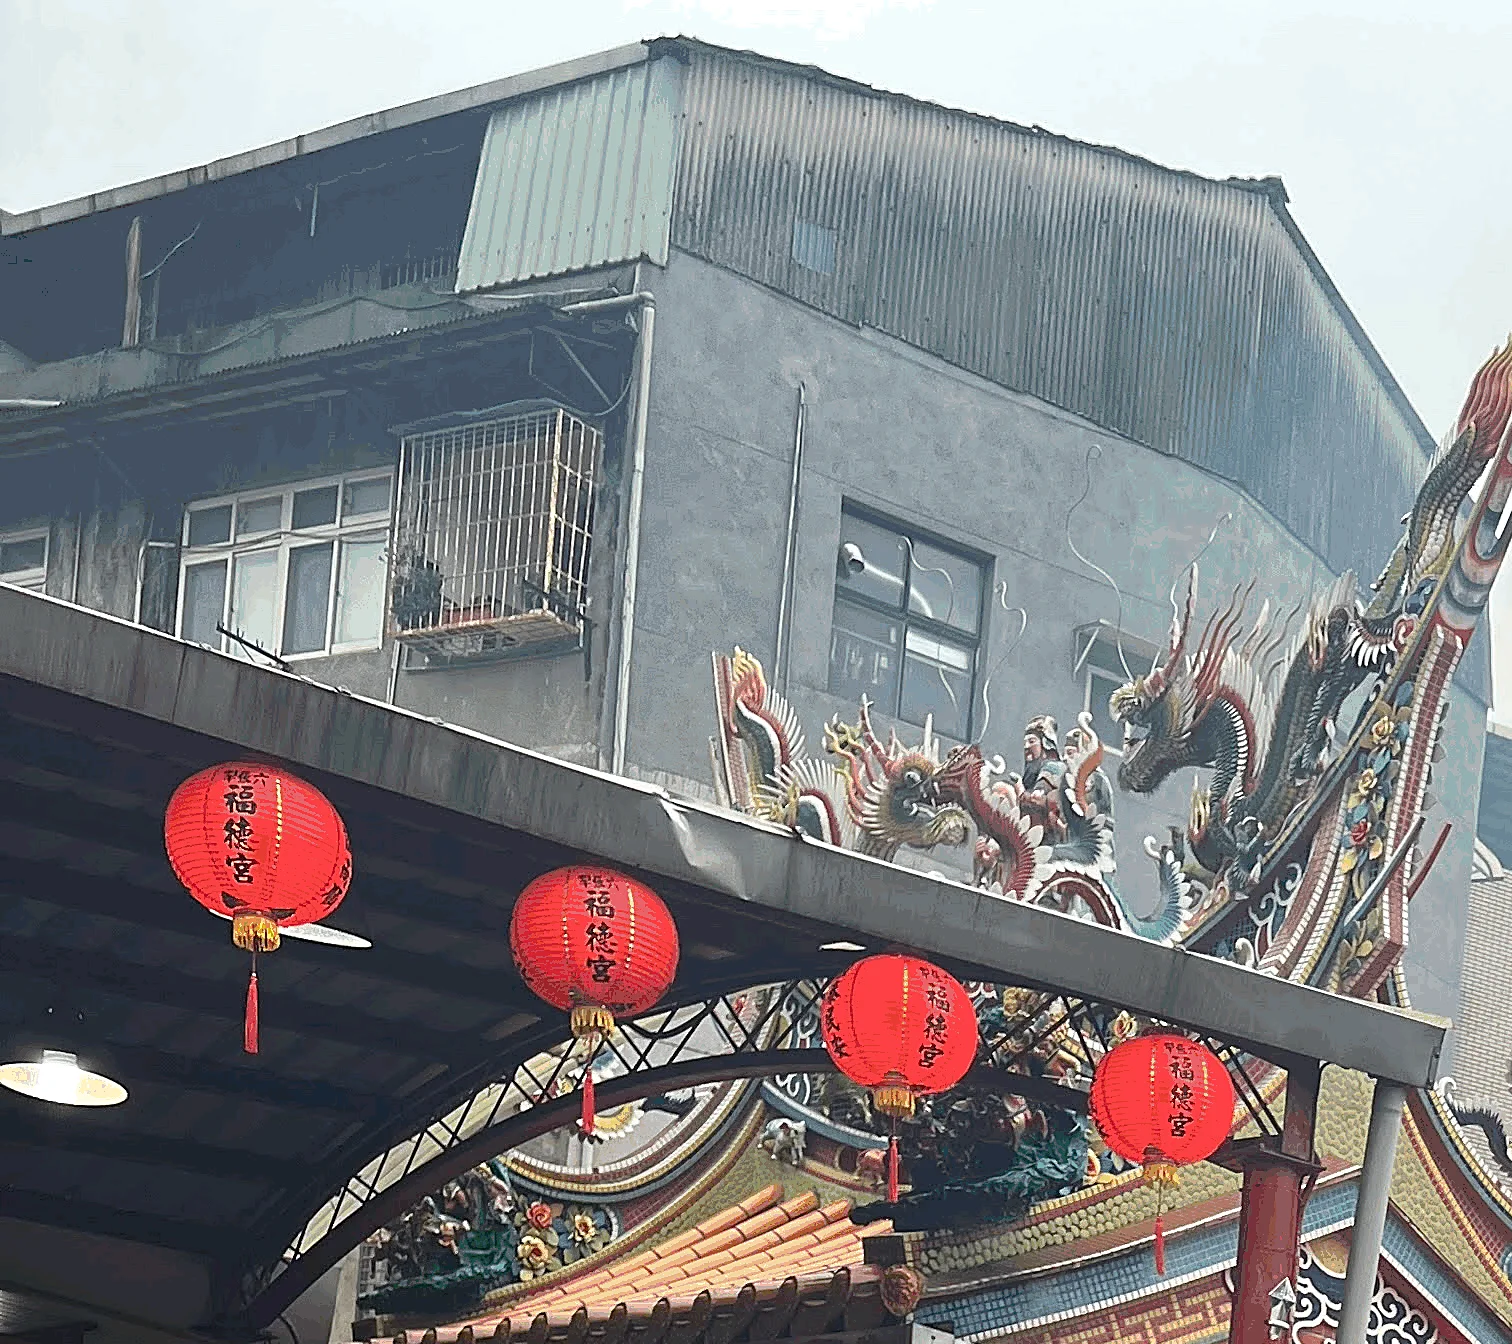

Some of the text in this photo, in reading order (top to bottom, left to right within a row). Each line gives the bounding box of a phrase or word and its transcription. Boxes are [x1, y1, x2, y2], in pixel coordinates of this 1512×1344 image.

[223, 784, 260, 885] 福德宮
[583, 890, 618, 984] 福德宮
[917, 982, 951, 1069] 福德宮
[1167, 1055, 1196, 1138] 福德宮
